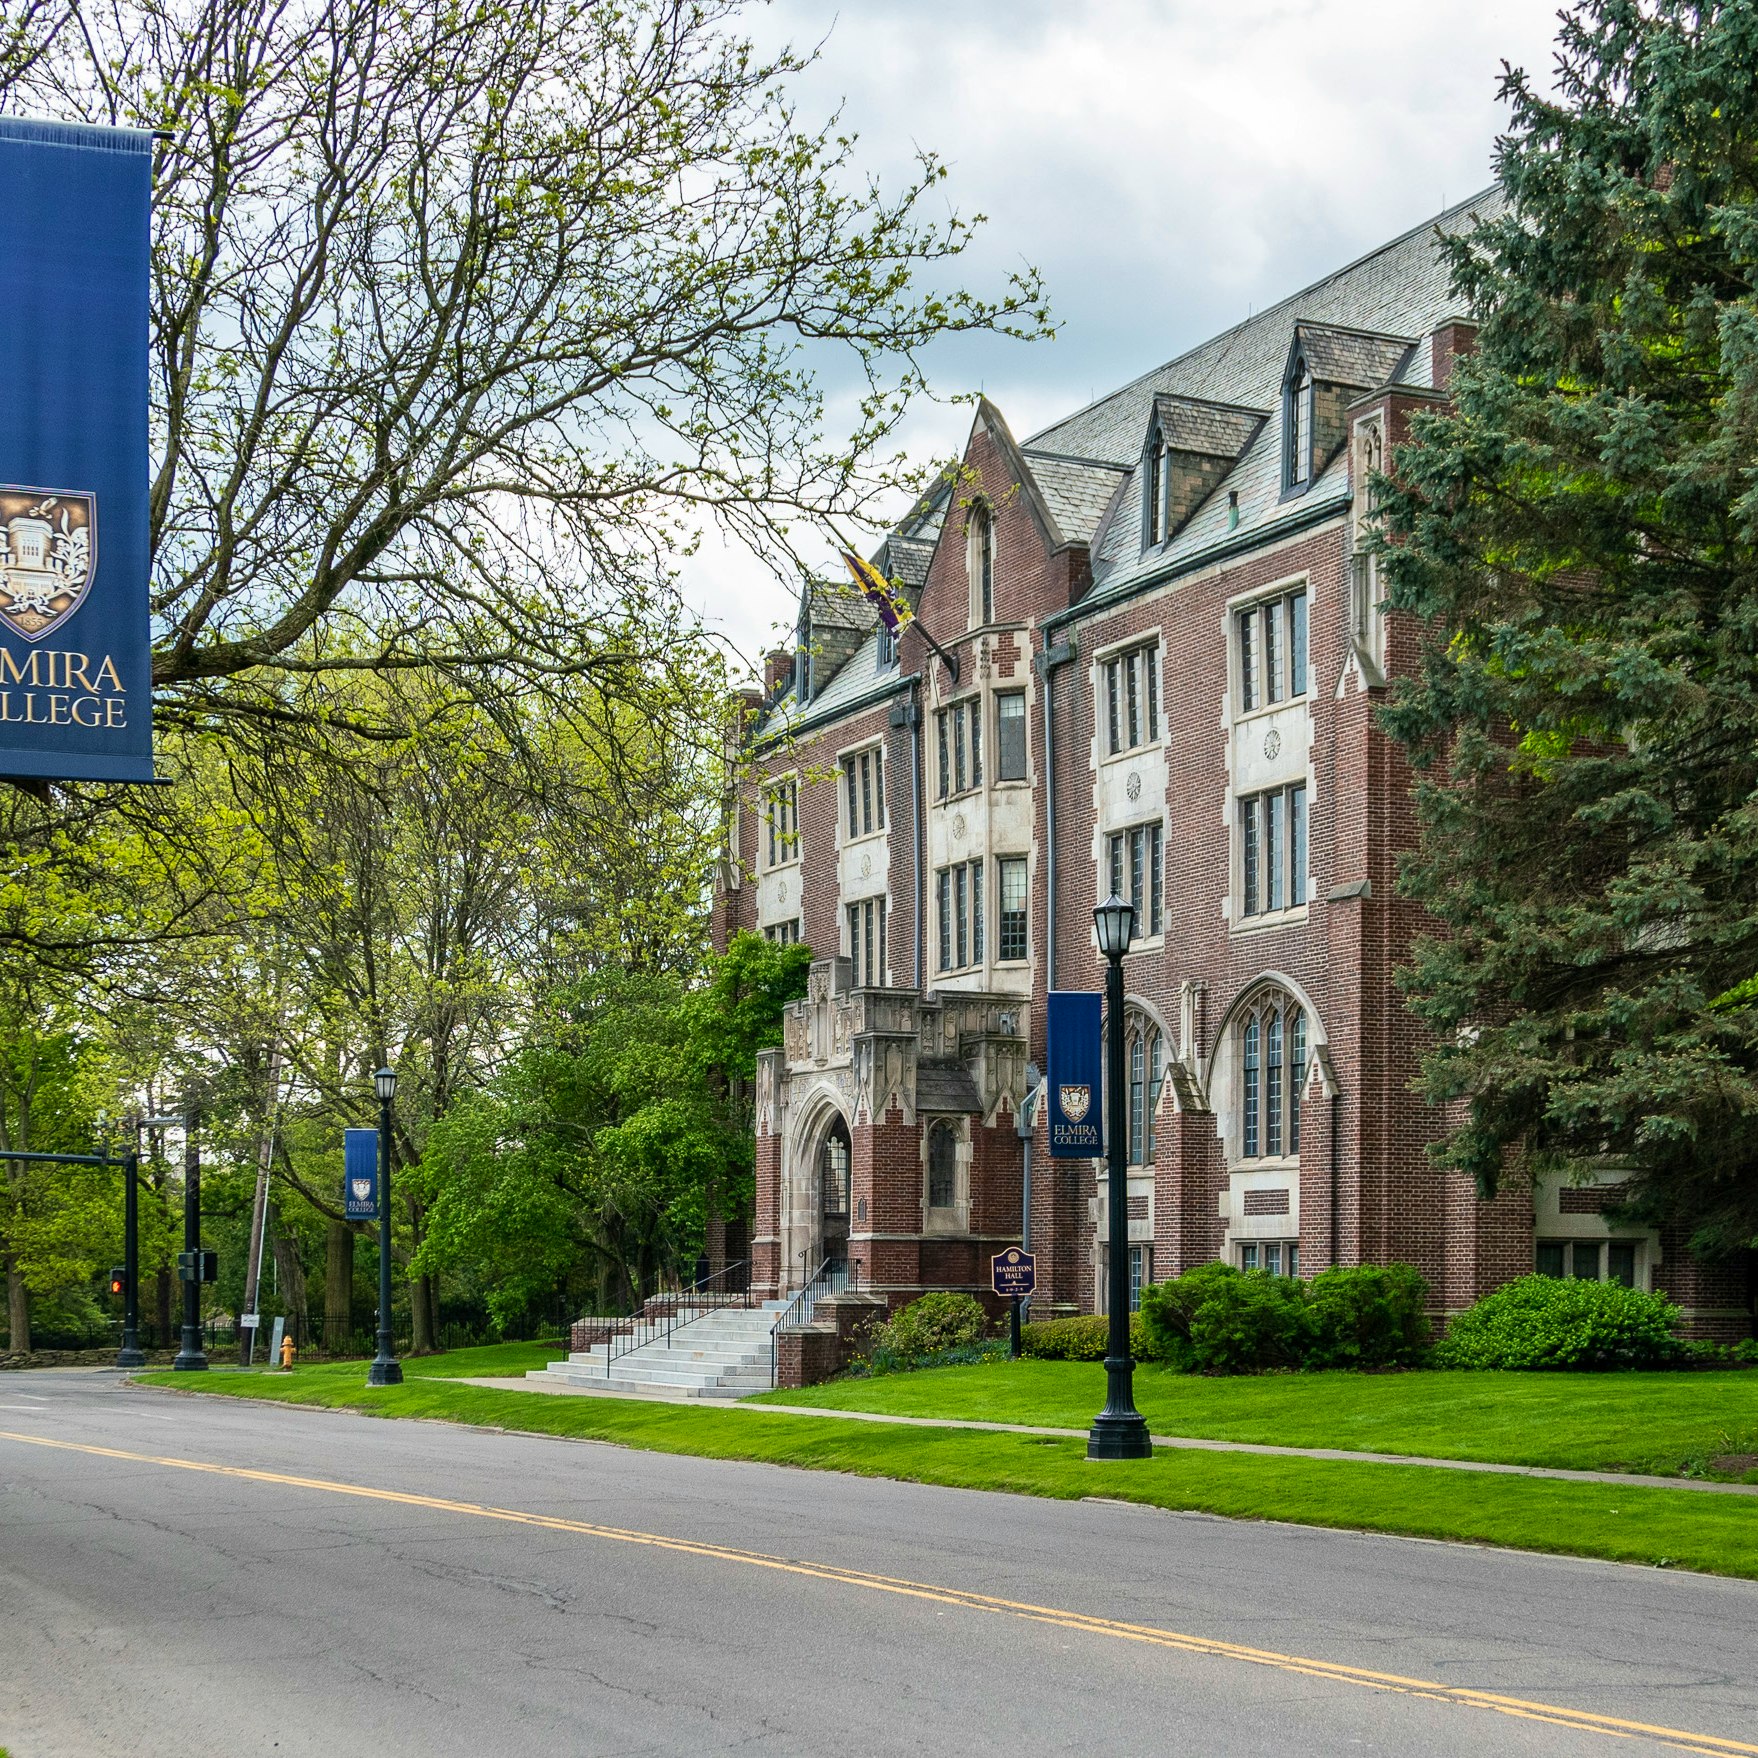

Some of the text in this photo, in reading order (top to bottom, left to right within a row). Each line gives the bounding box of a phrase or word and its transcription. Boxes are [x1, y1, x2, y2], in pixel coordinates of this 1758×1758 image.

[19, 615, 44, 627] 1855
[0, 647, 127, 694] MIRA
[0, 691, 128, 728] LLEGE
[1054, 1124, 1097, 1135] ELMIRA
[1054, 1136, 1098, 1145] COLLEGE
[348, 1200, 375, 1208] ELMIRA
[996, 1265, 1032, 1273] HAMILTON
[1004, 1272, 1023, 1280] HALL
